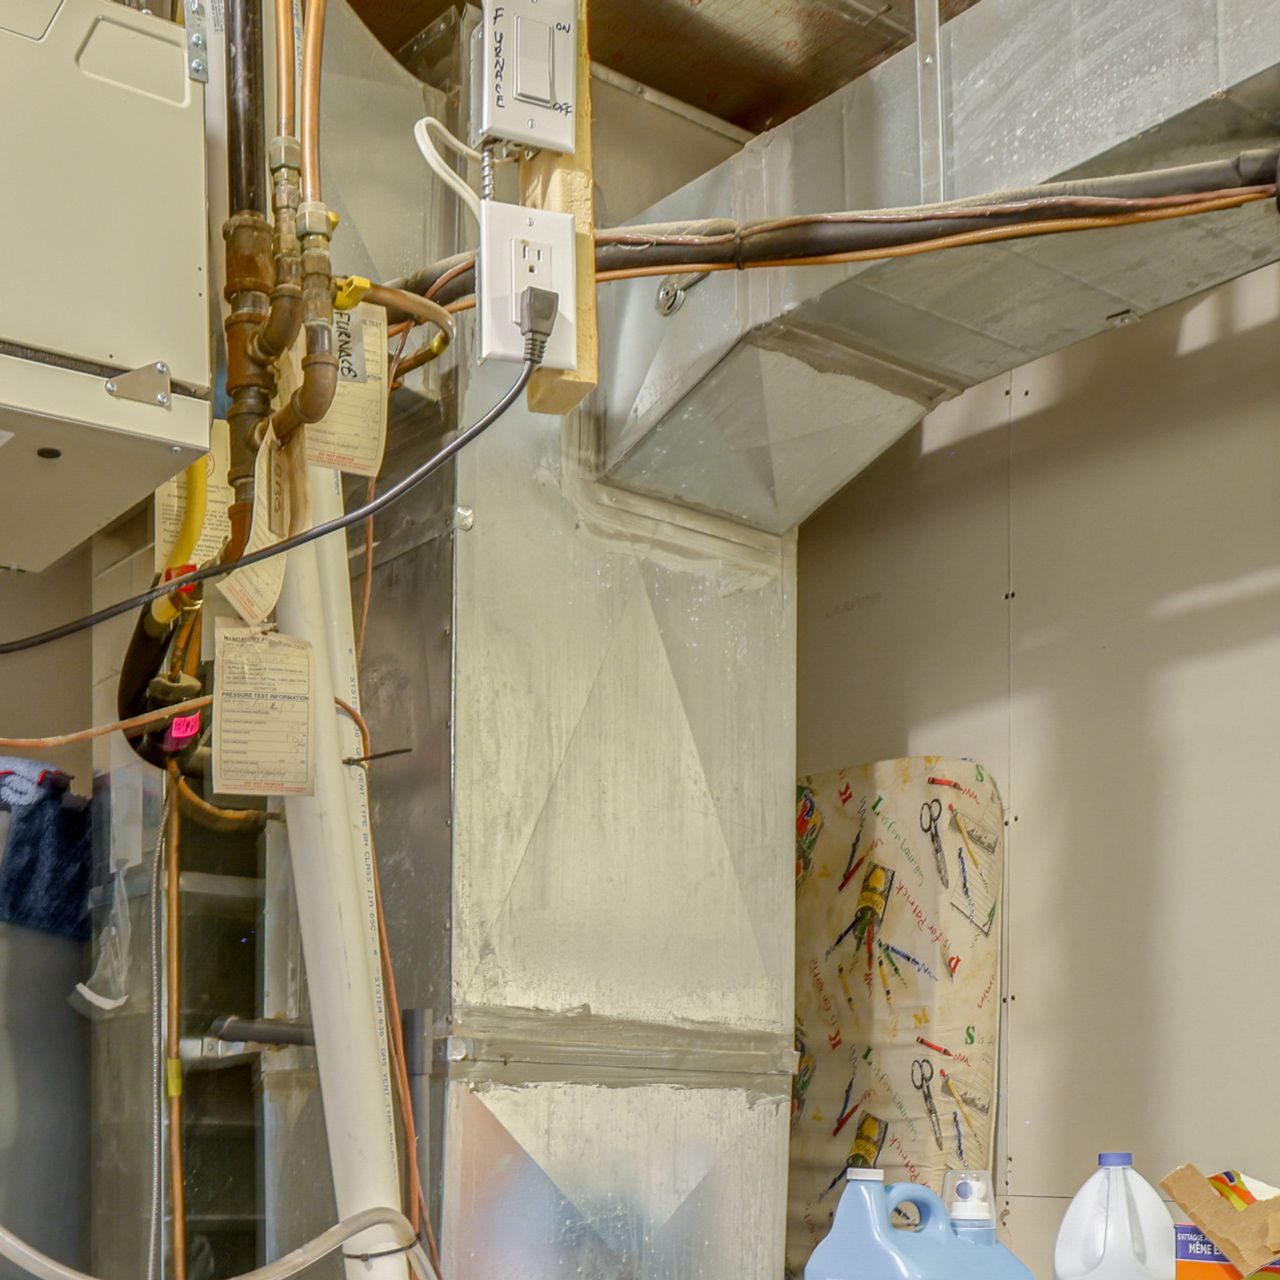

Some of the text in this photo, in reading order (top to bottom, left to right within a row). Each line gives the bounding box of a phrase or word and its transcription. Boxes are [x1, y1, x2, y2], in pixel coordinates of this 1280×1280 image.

[555, 22, 571, 34] ON
[493, 7, 505, 109] FURNACE
[552, 102, 573, 116] OFF
[358, 773, 366, 796] VENT
[374, 976, 384, 1014] SYSTEM
[1189, 1242, 1211, 1254] MÊME
